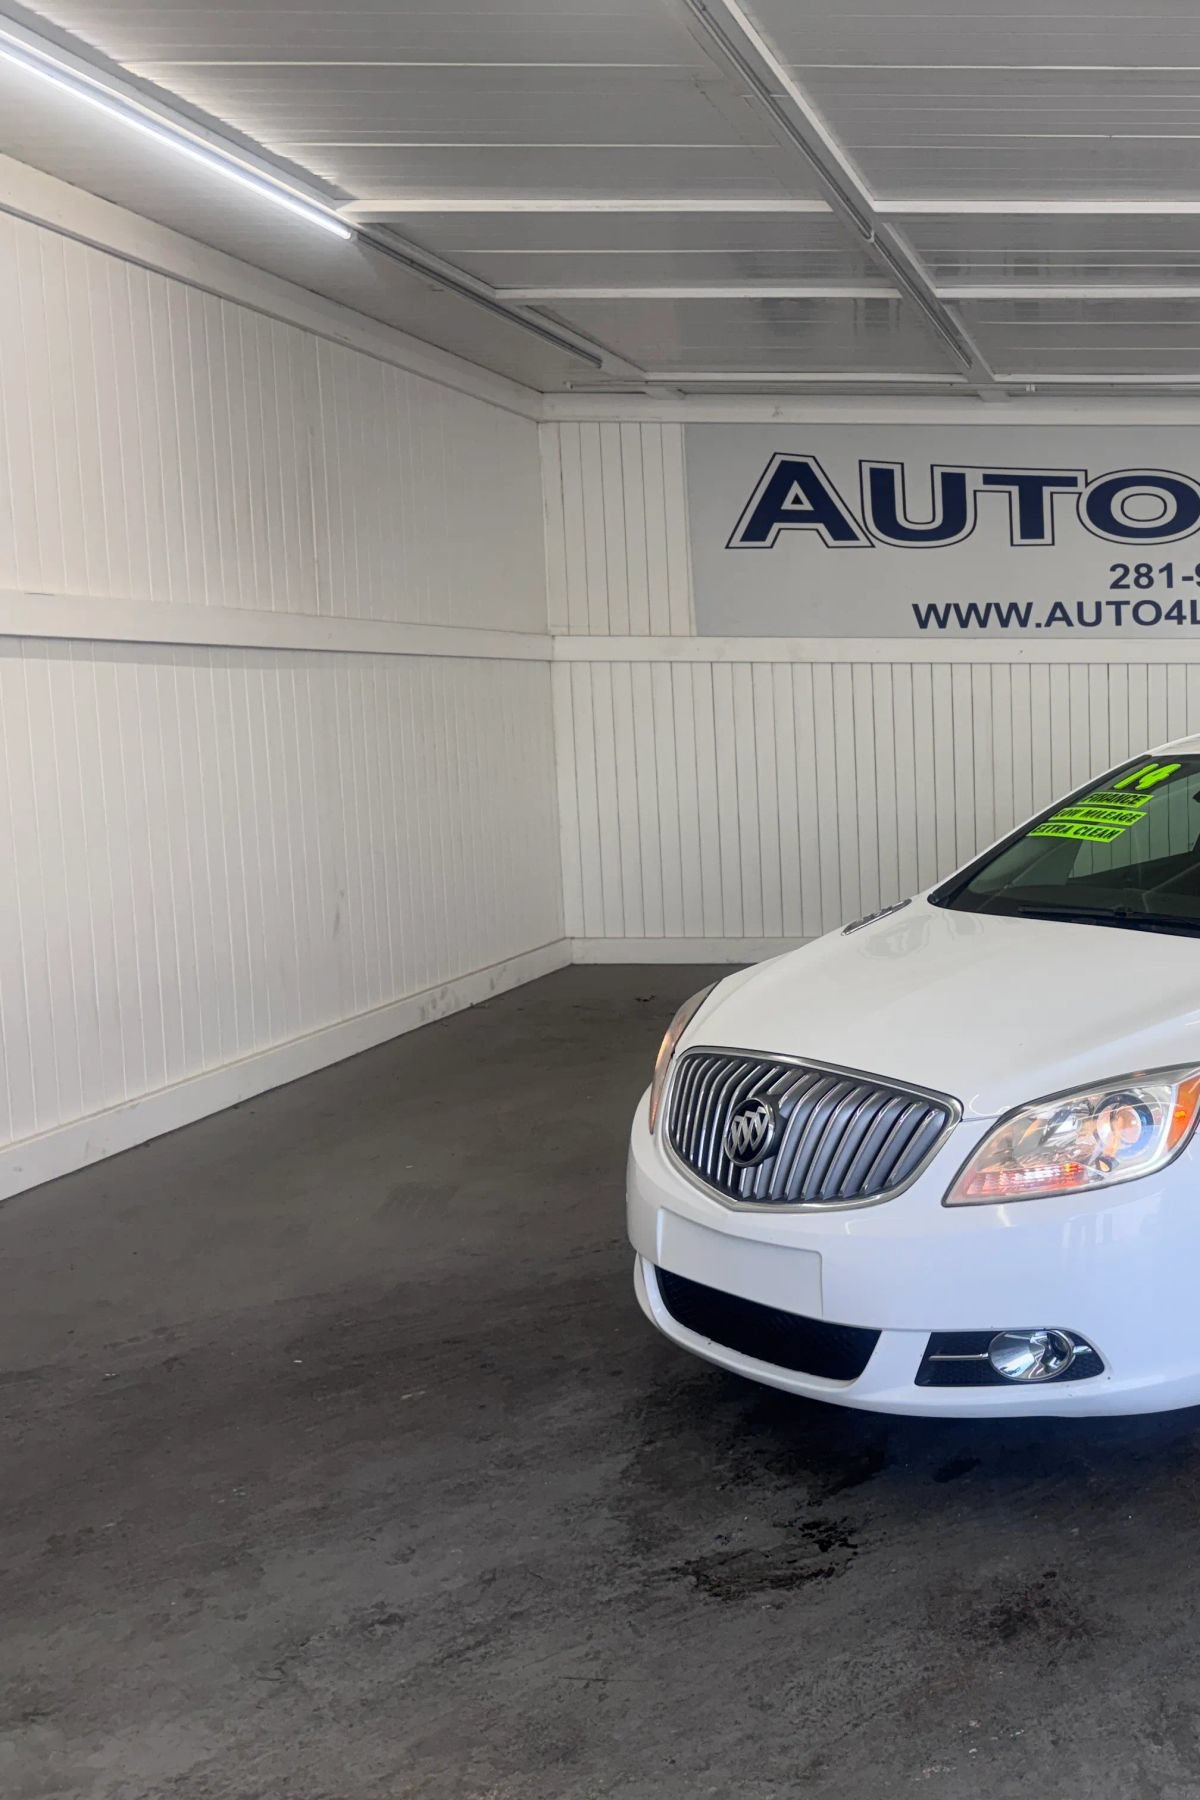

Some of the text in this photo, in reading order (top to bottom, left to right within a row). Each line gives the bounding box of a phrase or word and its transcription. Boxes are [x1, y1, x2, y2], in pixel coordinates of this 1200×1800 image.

[1083, 792, 1149, 806] FINANCE
[1053, 808, 1142, 823] LOW MILEAGE
[1031, 824, 1121, 840] EXTRA CLEAN
